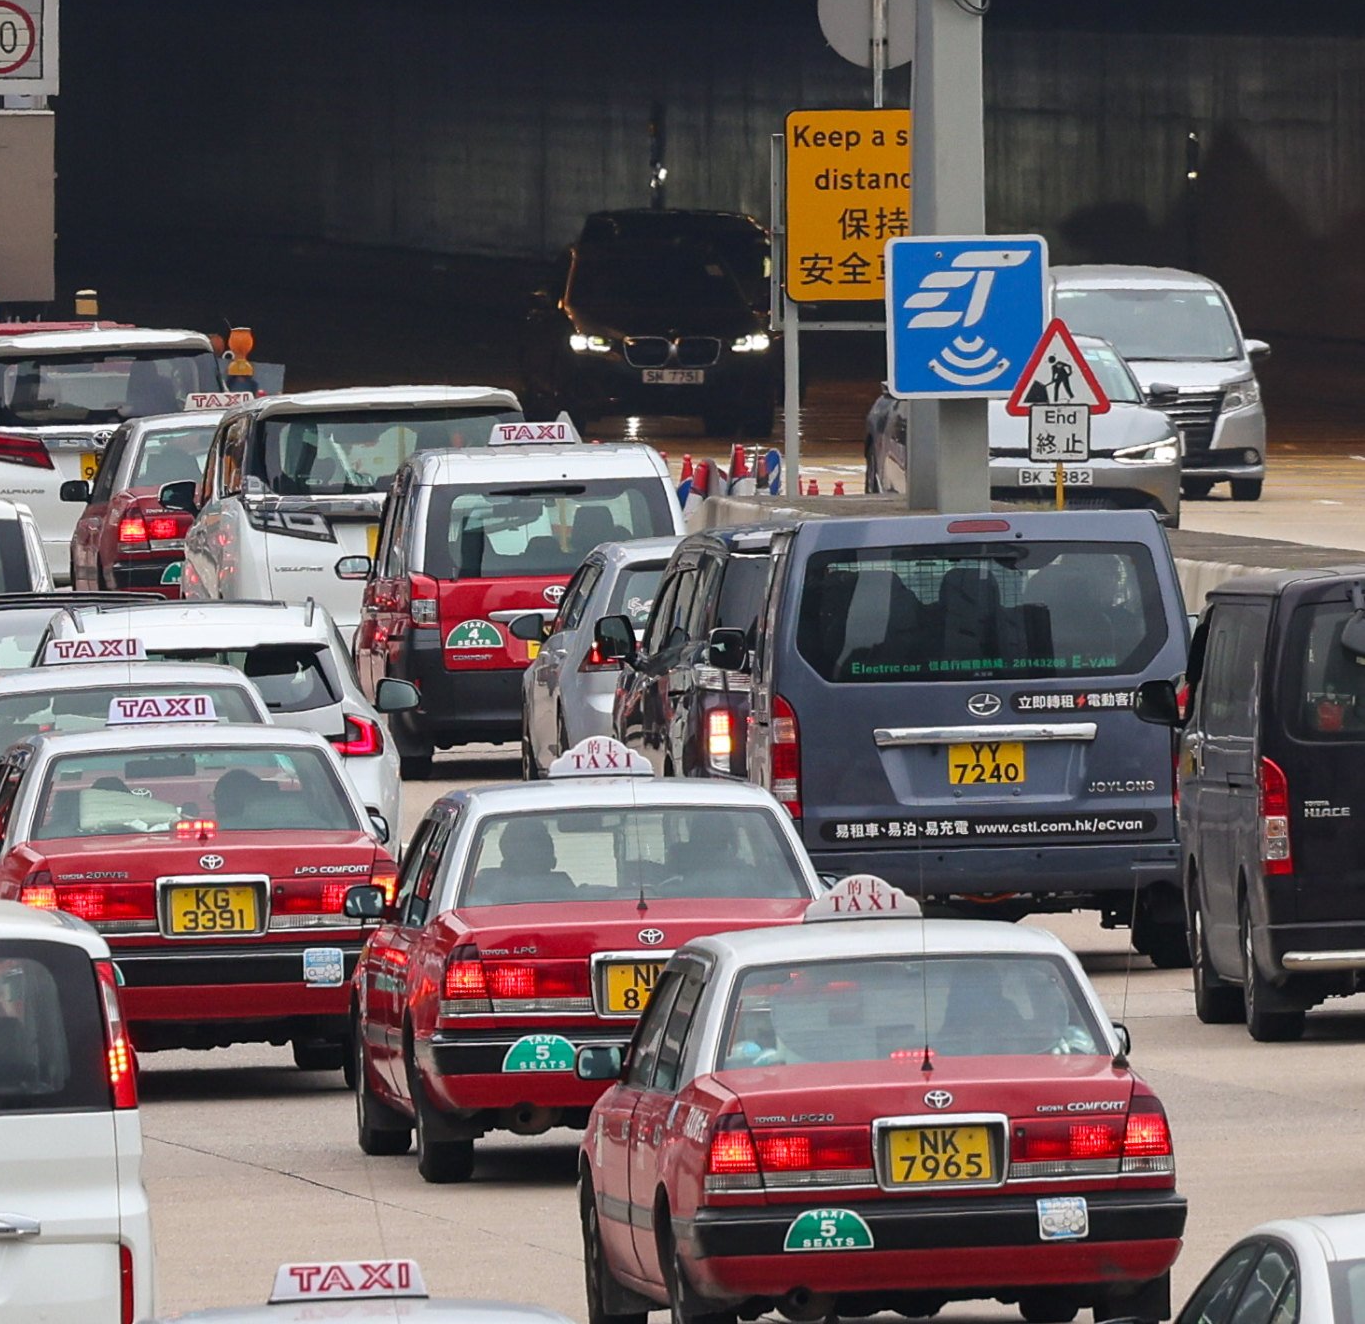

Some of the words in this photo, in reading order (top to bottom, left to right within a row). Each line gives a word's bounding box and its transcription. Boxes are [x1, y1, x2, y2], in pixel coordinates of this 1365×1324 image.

[793, 124, 860, 151] Keep
[871, 131, 885, 147] a
[837, 207, 910, 241] 保持
[191, 393, 250, 408] TAXI
[1044, 409, 1078, 425] End
[501, 425, 565, 441] TAXI
[1035, 432, 1084, 455] 終止
[1021, 470, 1042, 485] BK
[463, 621, 487, 629] TAXI
[468, 628, 480, 640] 4
[54, 639, 137, 659] TAXI
[457, 639, 492, 647] SEATS
[851, 661, 902, 675] Electric
[906, 665, 922, 674] car
[116, 697, 206, 718] TAXI
[1017, 694, 1075, 709] 立即轉租
[1087, 691, 1136, 707] 電動客
[587, 739, 617, 755] 的士
[970, 741, 1001, 764] YY
[571, 753, 632, 771] TAXI
[953, 763, 1020, 784] 7240
[1088, 780, 1156, 793] JOYLONG
[1304, 807, 1351, 818] HIACE
[974, 817, 1144, 835] www.cstl.com.hk/eCvan
[295, 866, 318, 875] LPG
[320, 863, 370, 875] COMFORT
[847, 878, 881, 896] 的士
[195, 888, 230, 910] KG
[829, 893, 898, 913] TAXI
[182, 908, 246, 931] 3391
[481, 948, 509, 957] TOYOTA
[513, 945, 538, 955] LPG
[526, 1035, 557, 1045] TAXI
[535, 1044, 551, 1061] 5
[519, 1060, 567, 1071] SEATS
[1036, 1103, 1064, 1113] CROWN
[1066, 1100, 1126, 1113] COMFORT
[754, 1115, 787, 1124] TOYOTA
[791, 1112, 835, 1123] LPG20
[919, 1130, 961, 1156] NK
[902, 1152, 984, 1182] 7965
[810, 1209, 846, 1220] TAXI
[819, 1219, 837, 1238] 5
[802, 1236, 856, 1249] SEATS
[289, 1262, 411, 1293] TAXI
